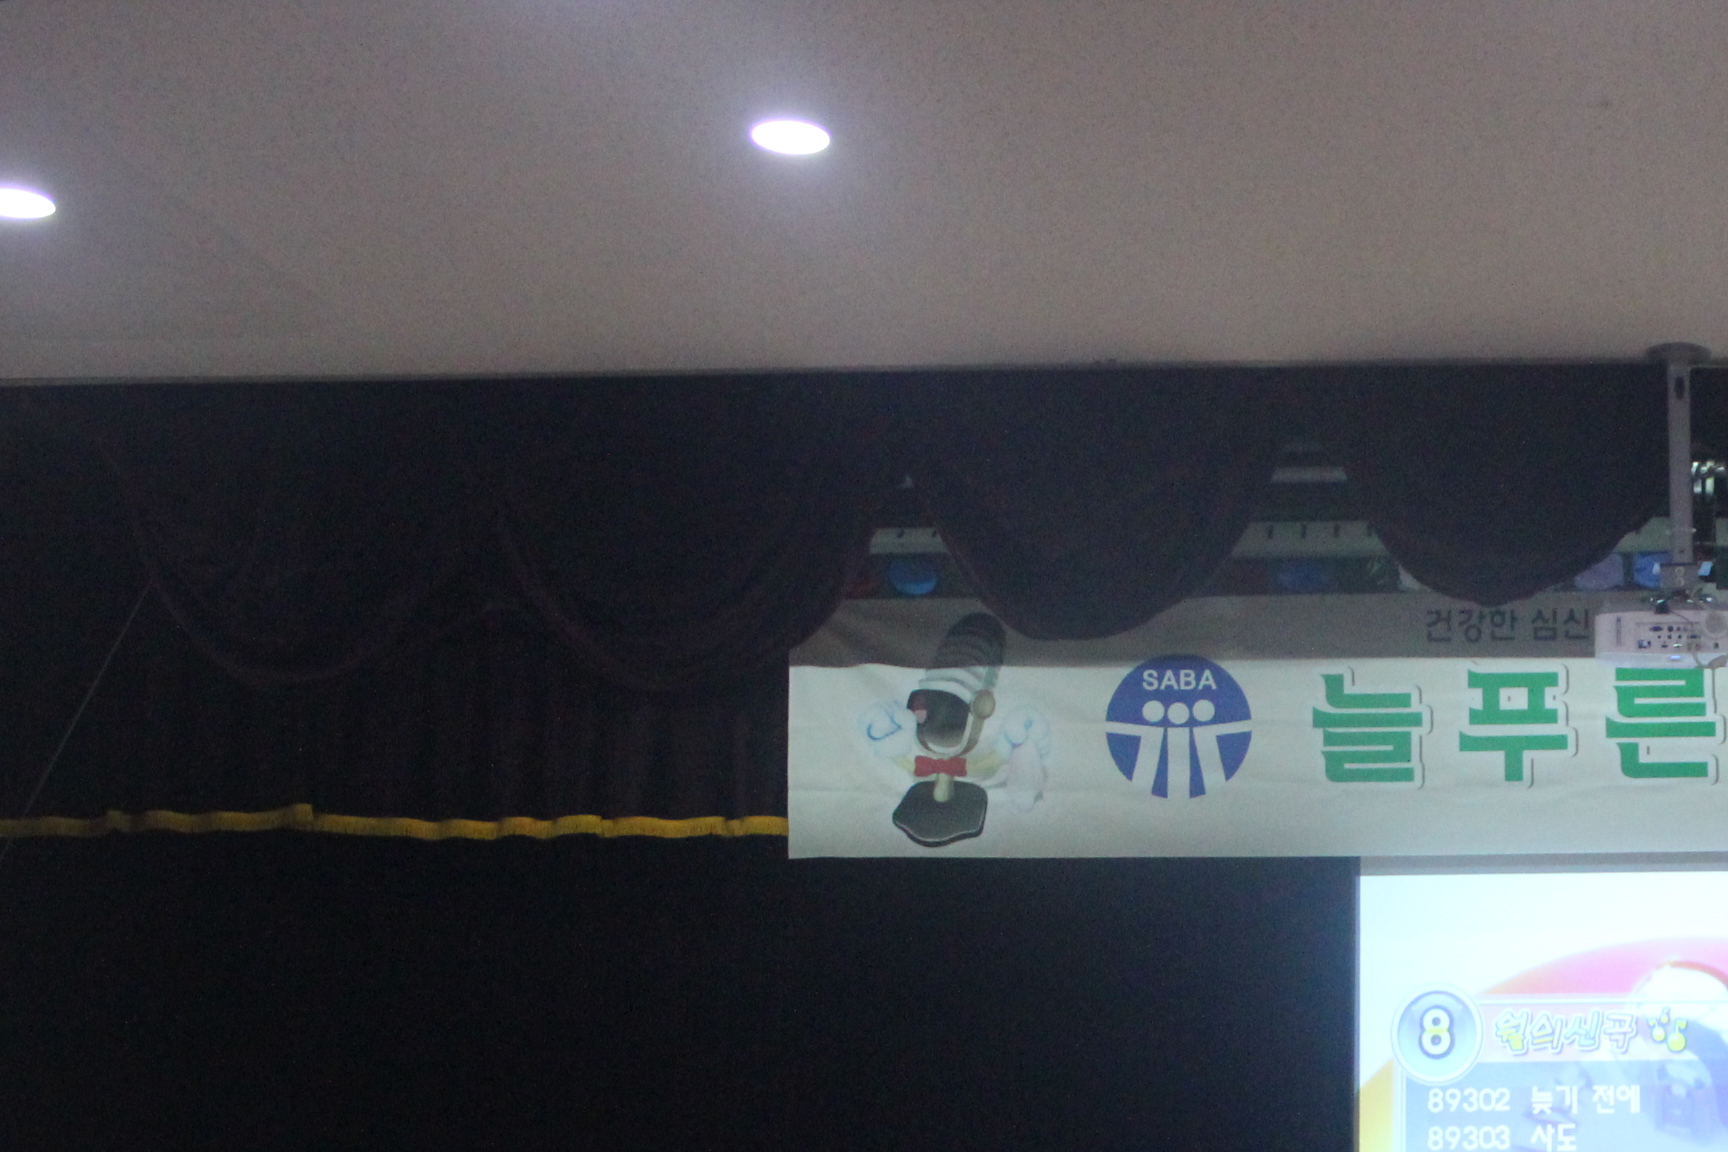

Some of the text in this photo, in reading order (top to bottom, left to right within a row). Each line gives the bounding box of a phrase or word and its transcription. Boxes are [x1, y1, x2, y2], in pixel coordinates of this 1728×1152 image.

[1427, 608, 1518, 642] 건강한
[1141, 669, 1218, 691] SABA
[1312, 666, 1726, 786] 늘푸른
[1419, 1005, 1455, 1058] 8
[1427, 1088, 1511, 1113] 89302
[1531, 1085, 1578, 1115] 늦기
[1592, 1085, 1641, 1114] 전에
[1427, 1126, 1511, 1151] 89303
[1530, 1124, 1577, 1152] 사도
